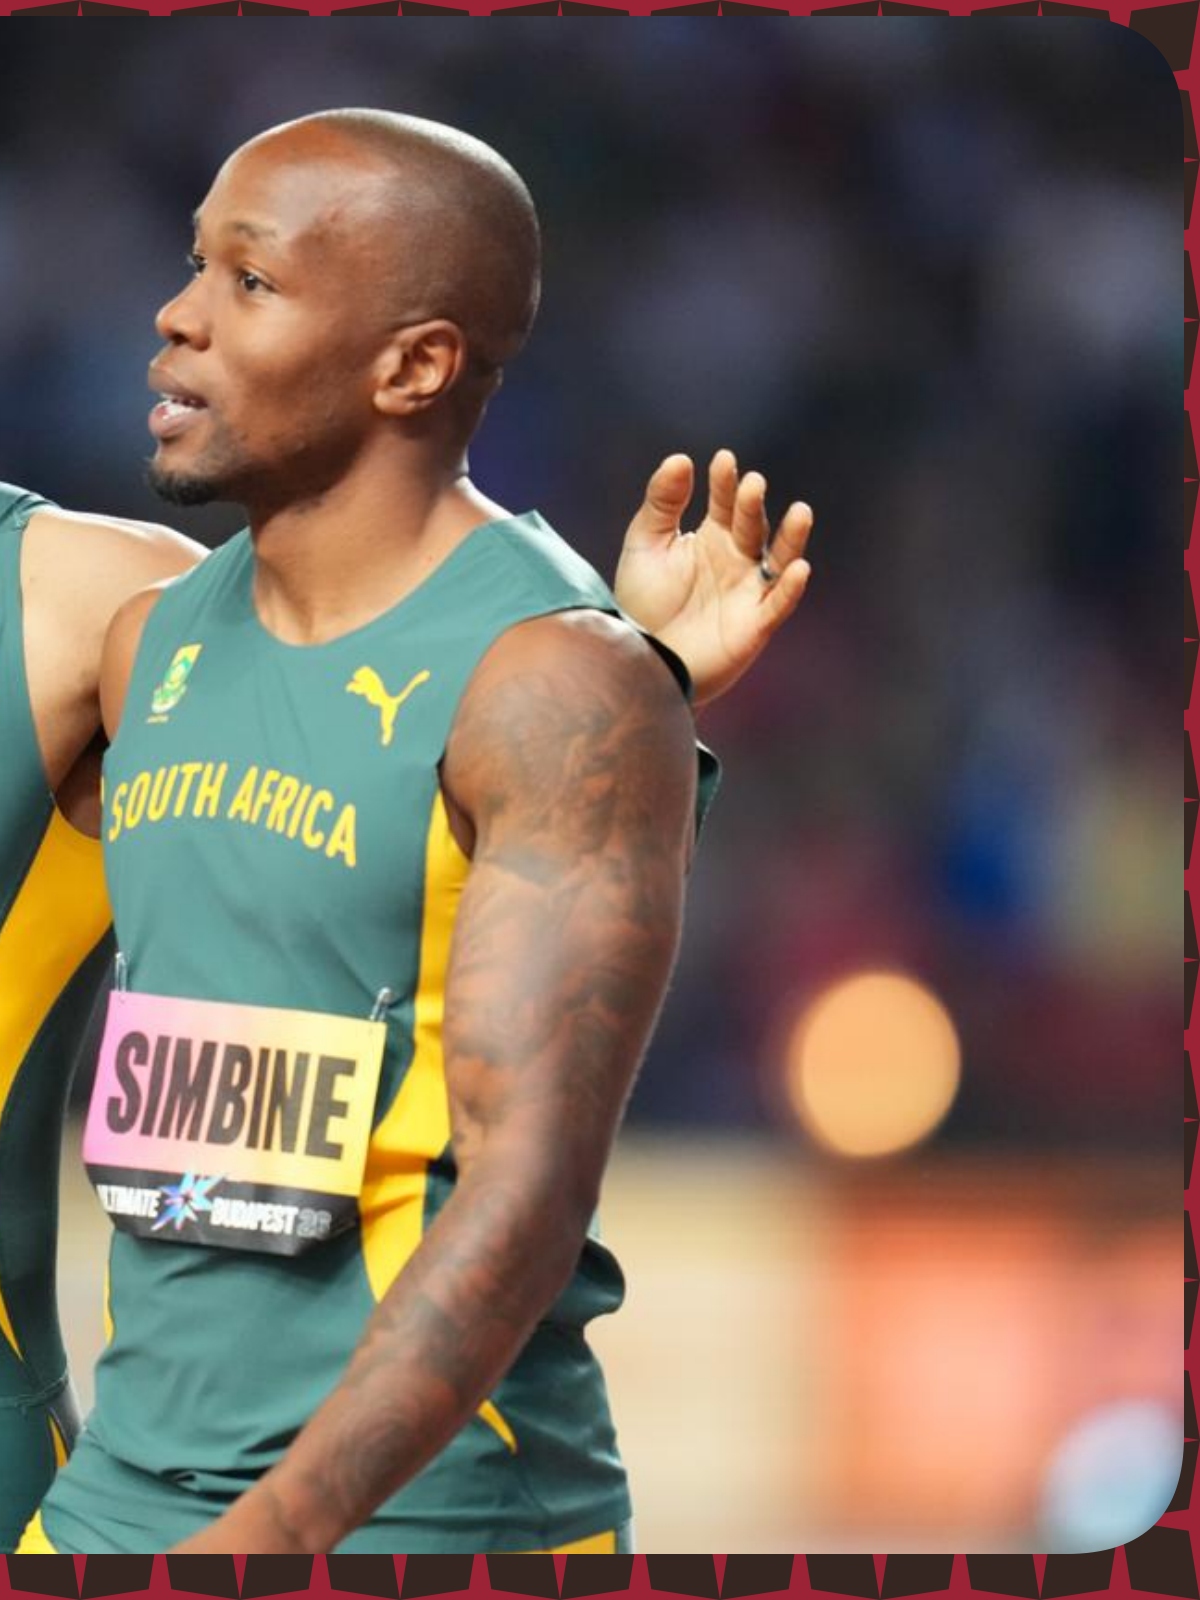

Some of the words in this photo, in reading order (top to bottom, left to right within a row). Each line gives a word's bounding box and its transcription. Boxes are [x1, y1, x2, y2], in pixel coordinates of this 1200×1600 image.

[108, 762, 228, 842] SOUTH
[227, 765, 356, 867] AFRICA
[102, 1031, 357, 1160] SIMBINE
[210, 1197, 299, 1235] BUDAPEST
